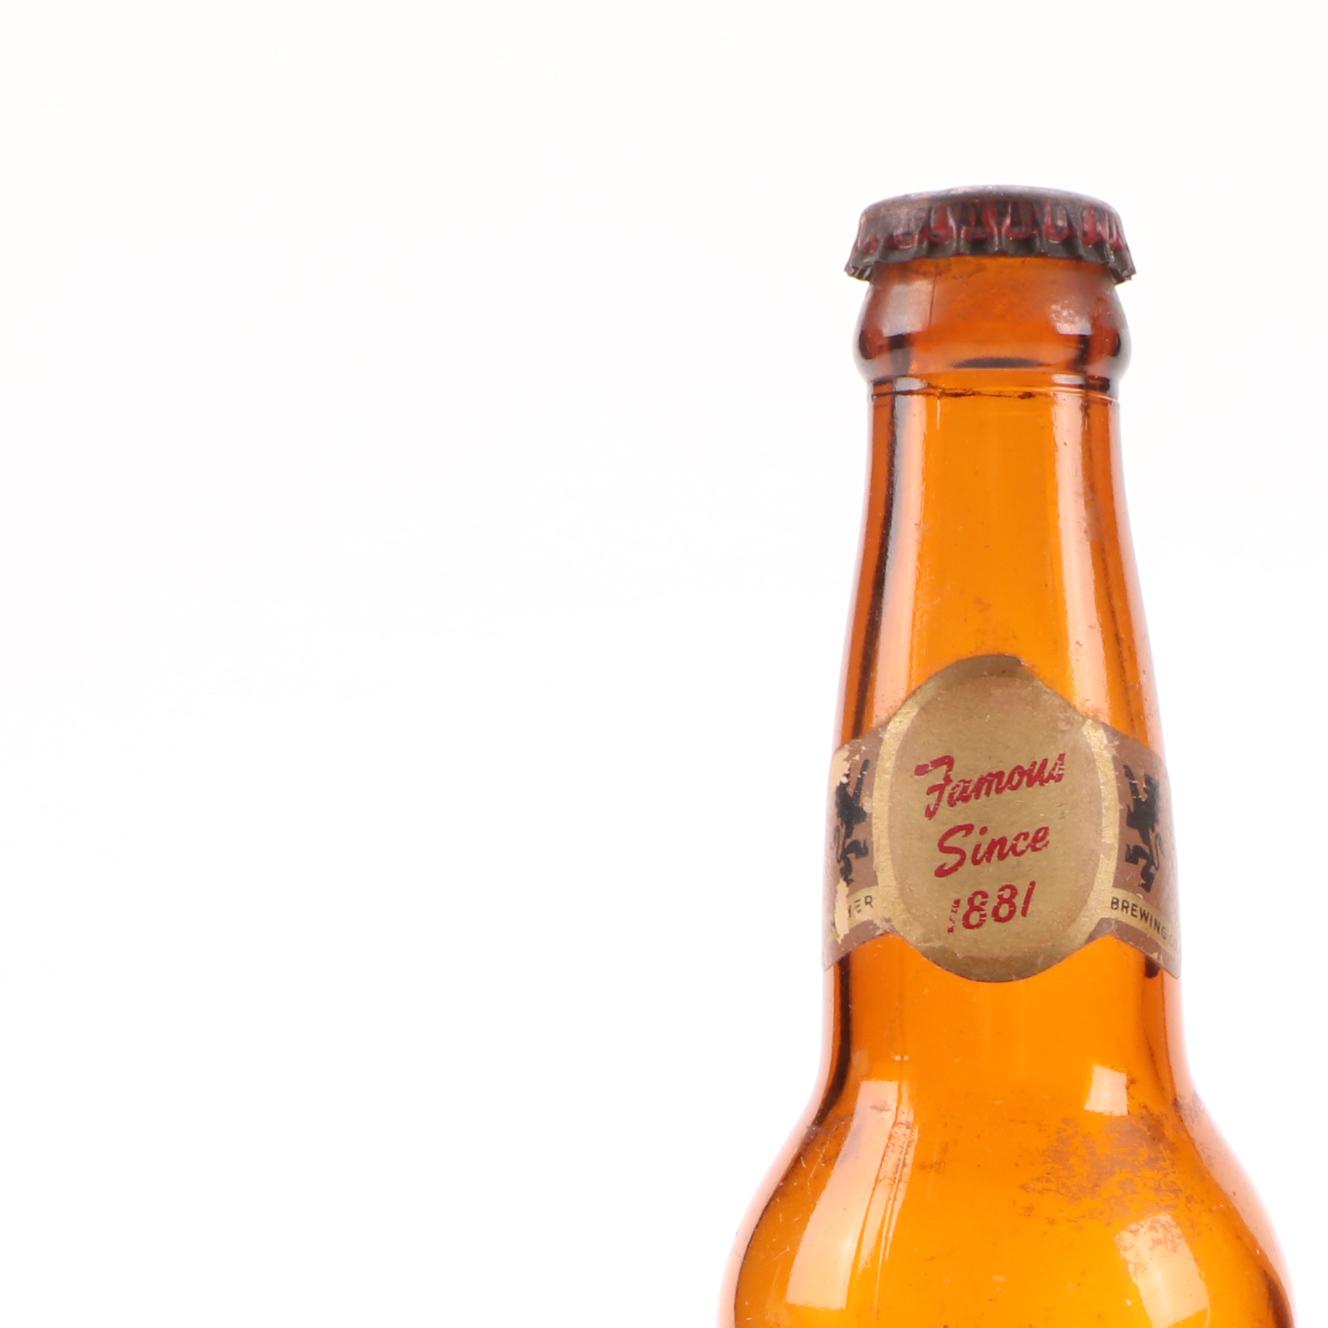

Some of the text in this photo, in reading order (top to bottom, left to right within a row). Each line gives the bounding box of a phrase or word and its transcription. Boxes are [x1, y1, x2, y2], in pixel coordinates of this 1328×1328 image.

[914, 753, 1066, 820] Famous
[934, 824, 1050, 878] Since
[947, 881, 1036, 934] 1881
